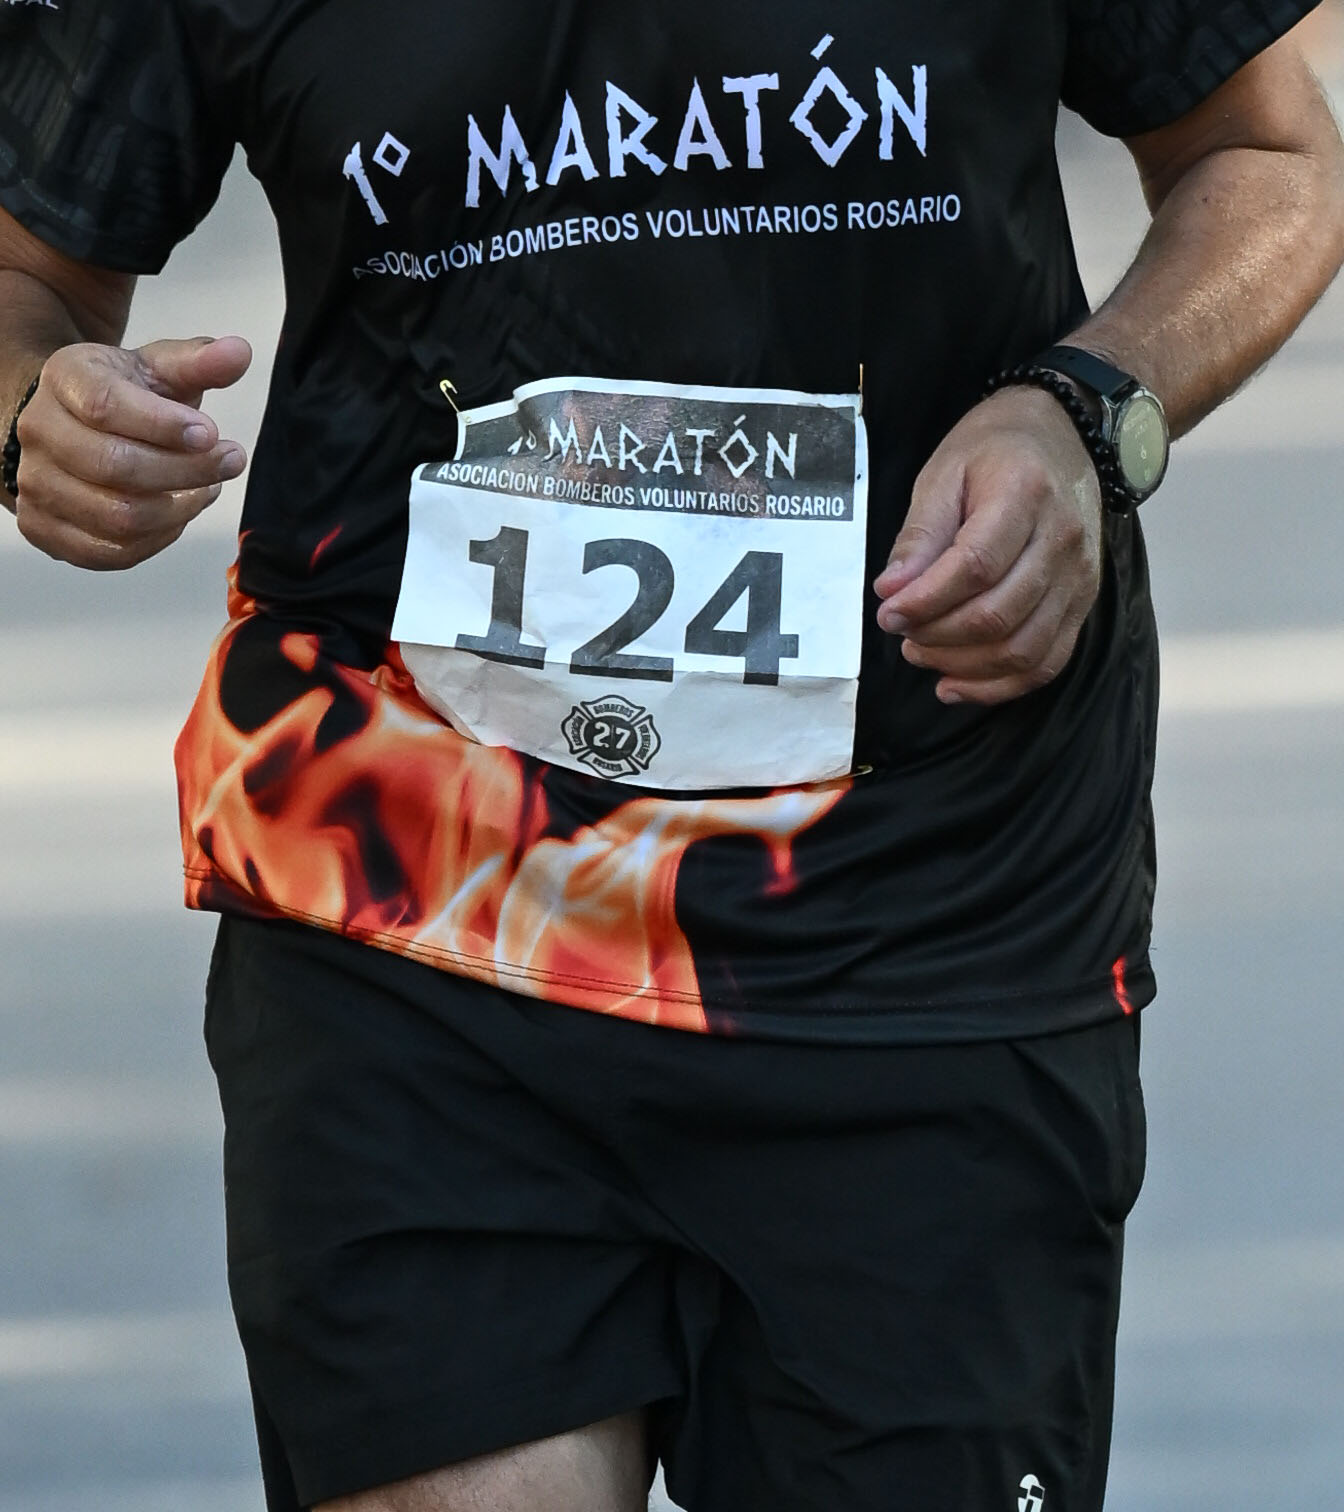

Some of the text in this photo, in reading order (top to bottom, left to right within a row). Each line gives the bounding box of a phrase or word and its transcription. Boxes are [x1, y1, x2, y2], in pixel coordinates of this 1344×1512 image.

[465, 34, 928, 208] MARATÓN
[353, 194, 962, 281] ASOCIACIÓN BOMBEROS VOLUNTARIOS ROSARIO
[544, 414, 798, 480] MARATÓN
[544, 478, 635, 506] BOMBEROS
[640, 488, 760, 514] VOLUNTARIOS
[765, 495, 845, 517] ROSARIO
[455, 525, 799, 686] 124
[593, 721, 631, 750] 27
